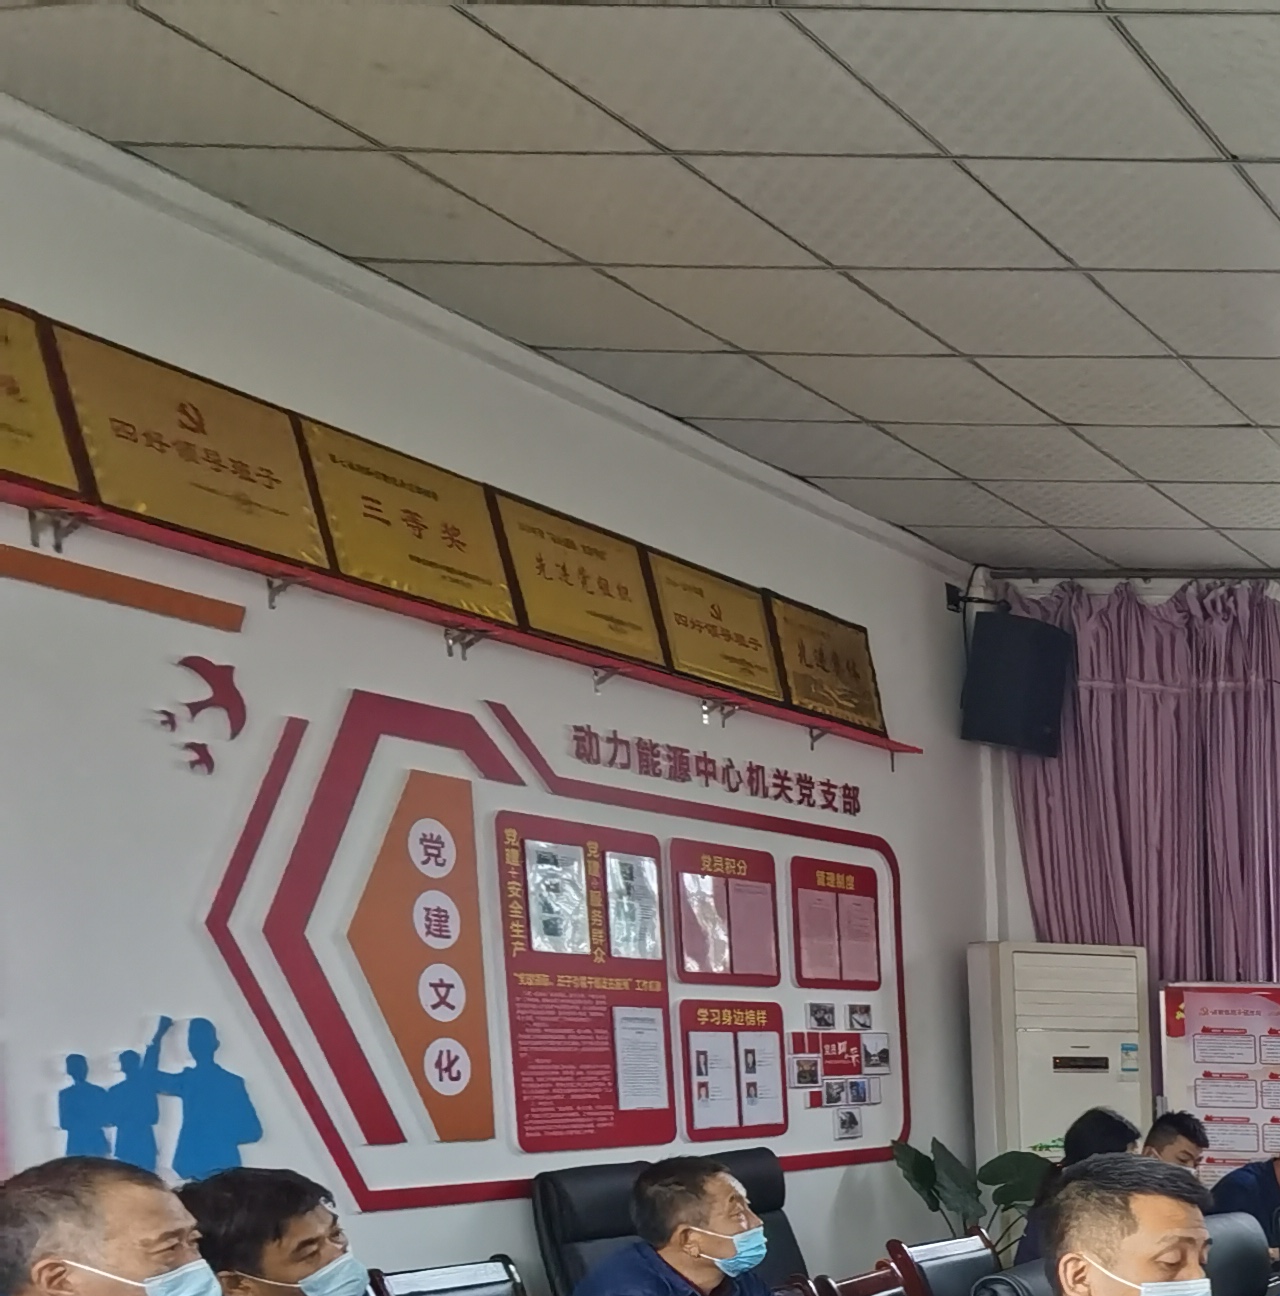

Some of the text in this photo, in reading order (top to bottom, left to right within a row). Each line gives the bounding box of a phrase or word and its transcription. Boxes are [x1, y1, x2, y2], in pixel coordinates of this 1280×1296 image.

[109, 416, 283, 490] 四好领导班子
[360, 494, 469, 554] 三等奖
[673, 611, 763, 652] 四好领导班子
[571, 723, 862, 817] 动力能源中心机关党支部
[701, 852, 748, 876] 党员积分
[419, 831, 463, 1083] 党建文化
[696, 1007, 769, 1028] 学习身边榜样
